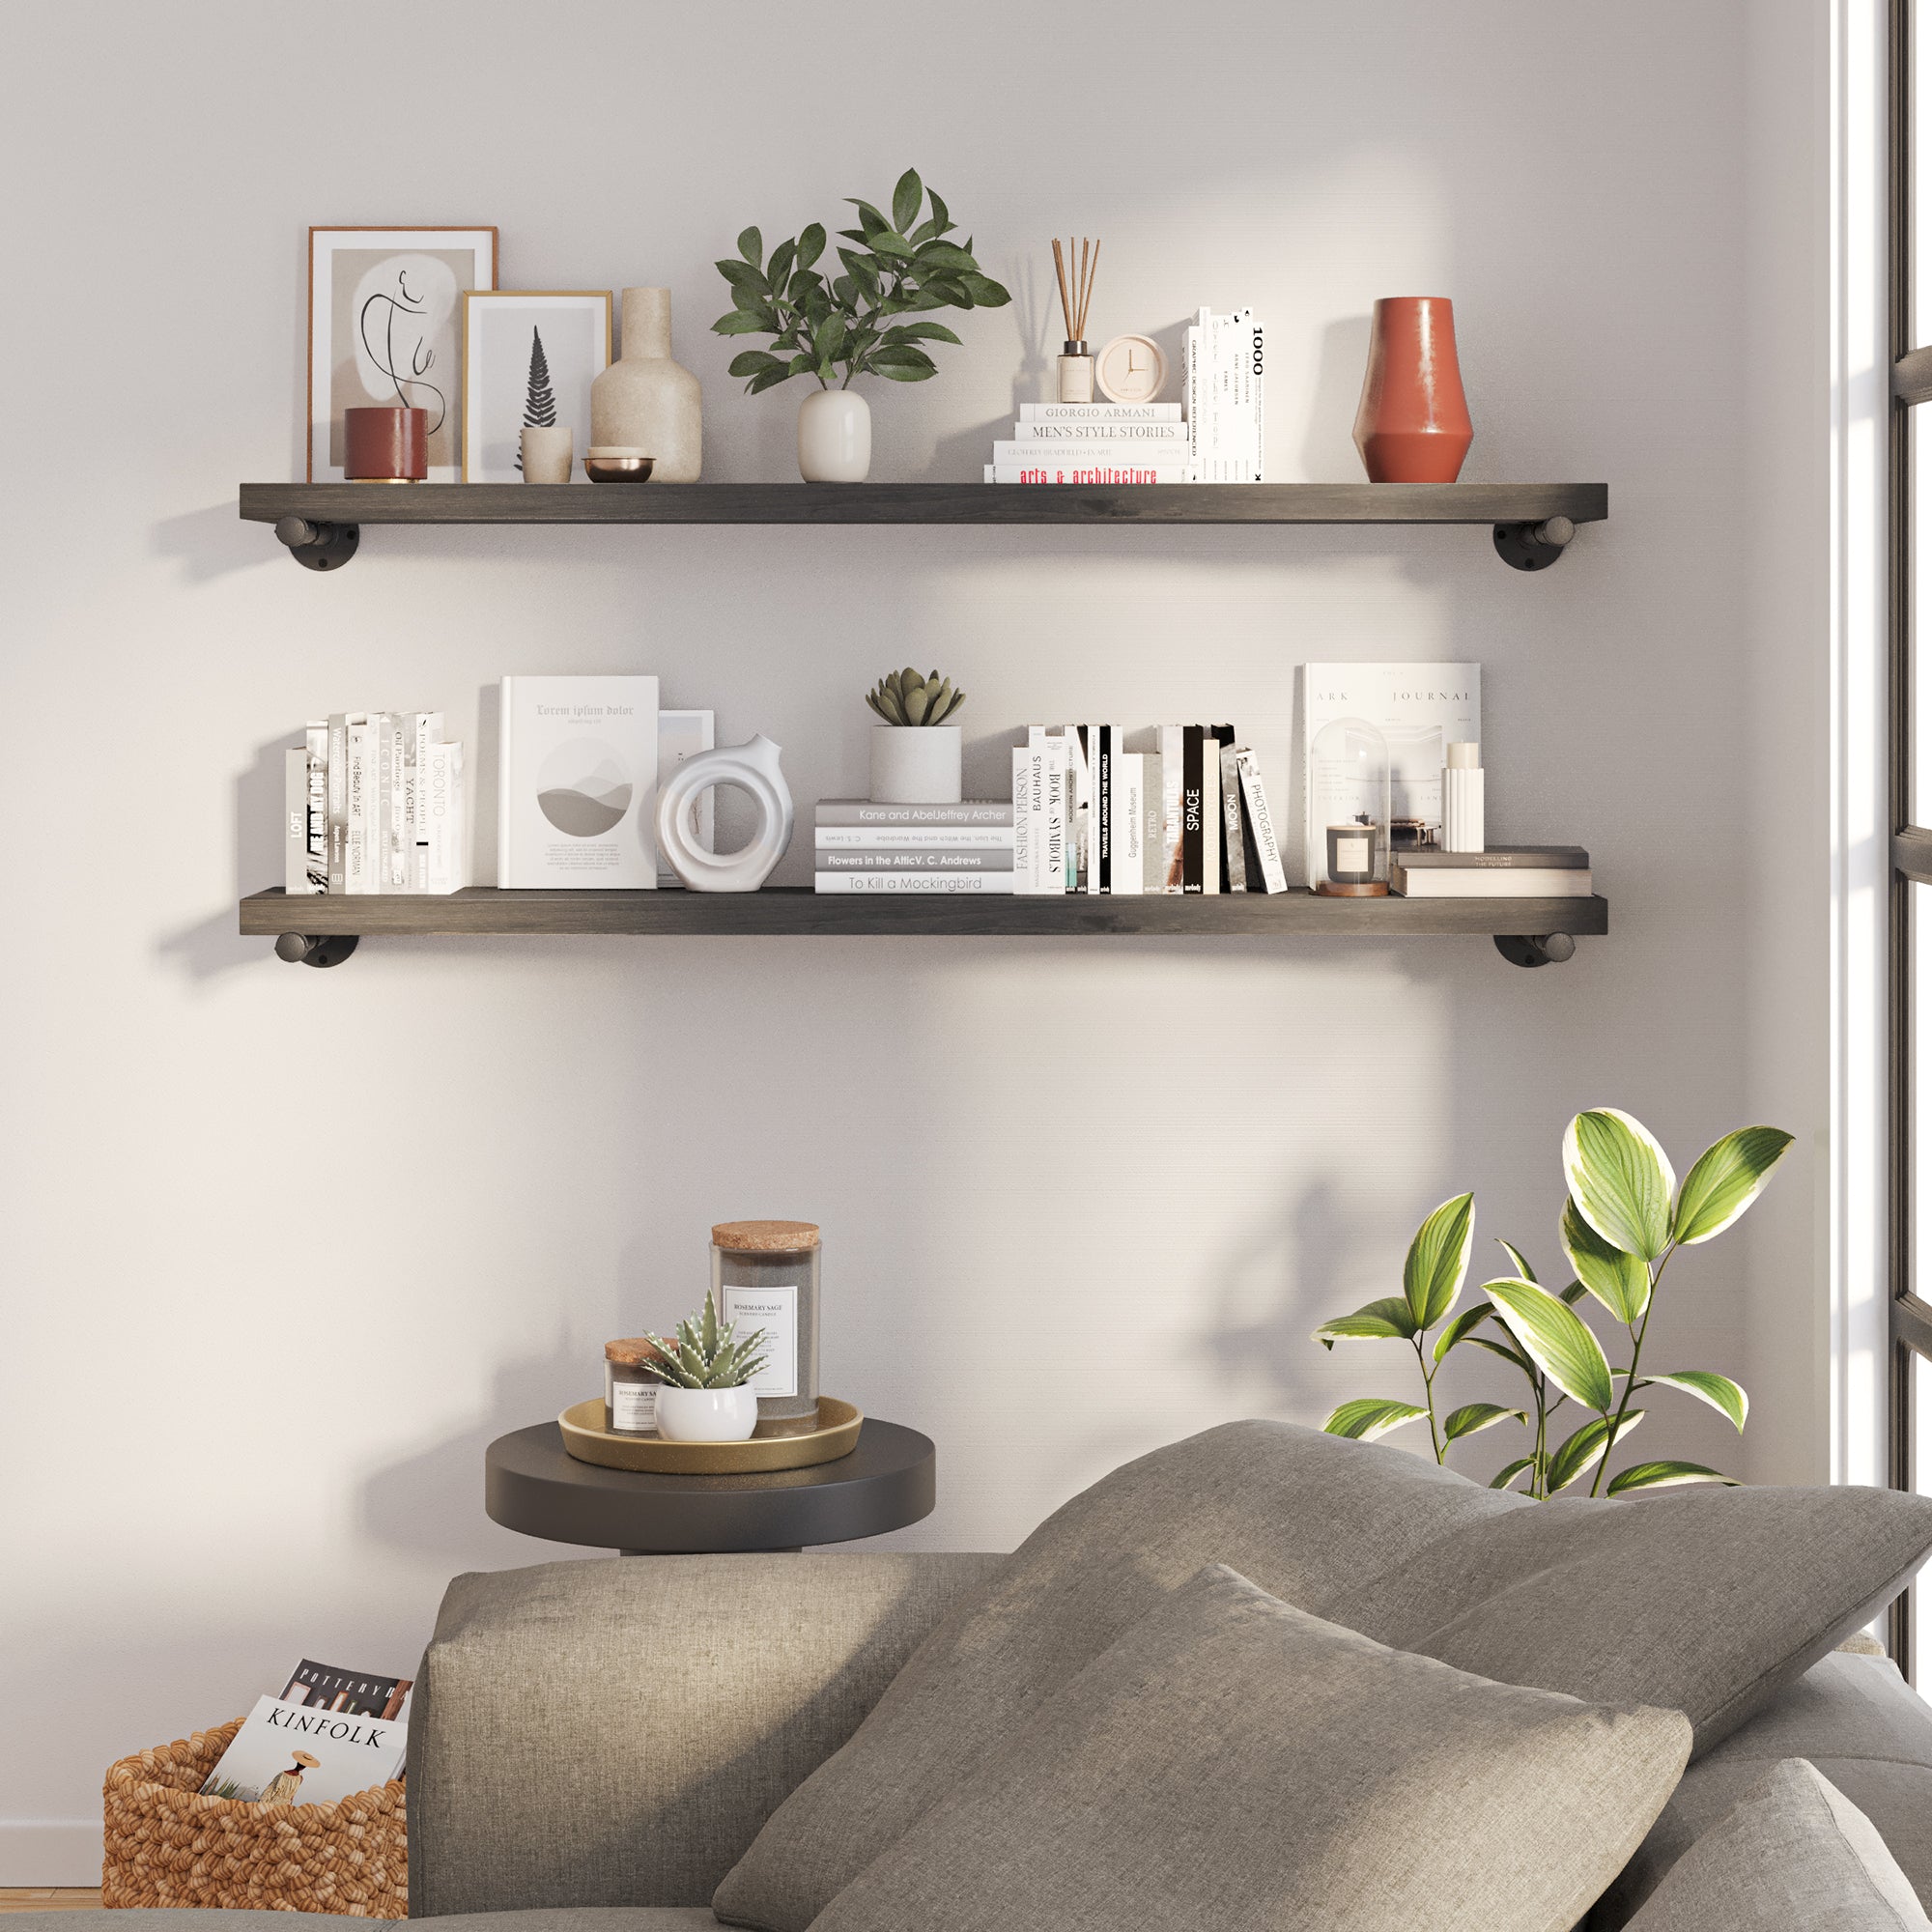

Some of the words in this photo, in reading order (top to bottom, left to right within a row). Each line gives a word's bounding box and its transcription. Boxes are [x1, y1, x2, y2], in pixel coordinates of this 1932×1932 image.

[1252, 326, 1264, 376] 1000
[1045, 408, 1099, 417] GIORGIO
[1103, 408, 1155, 417] ARMANI
[1033, 426, 1072, 439] MEN'S
[1075, 426, 1117, 439] STYLE
[1120, 426, 1175, 439] STORIES
[1020, 467, 1047, 484] arts
[1056, 469, 1065, 484] &
[1072, 467, 1157, 484] architecture
[536, 703, 570, 716] Lorem
[606, 704, 635, 716] dolor
[1316, 691, 1349, 701] ARK
[1392, 691, 1470, 702] JOURNAL
[331, 726, 343, 775] Watercolor
[393, 731, 403, 745] Oil
[352, 756, 362, 770] Find
[381, 739, 390, 806] ICONIC
[310, 772, 325, 794] DOG
[331, 777, 343, 813] Portraits
[351, 771, 362, 794] Beauty
[432, 753, 446, 817] TORONTO
[1016, 767, 1028, 813] PERSON
[1032, 755, 1041, 811] BAUHAUS
[1048, 773, 1061, 806] BOOK
[310, 796, 325, 811] MY
[351, 804, 361, 817] ART
[406, 778, 415, 824] YACHT
[859, 810, 886, 820] Kane
[888, 810, 910, 820] and
[972, 810, 1006, 820] Archer
[1128, 786, 1137, 815] Museum
[1166, 781, 1179, 843] TARANTULAS
[1186, 788, 1200, 832] SPACE
[1226, 793, 1238, 831] MOON
[290, 810, 302, 838] LOFT
[310, 813, 325, 835] AND
[1148, 810, 1157, 838] RETRO
[1207, 772, 1217, 861] MOTORCYCLES
[1250, 783, 1278, 863] PHOTOGRAPHY
[310, 837, 325, 851] ME
[351, 830, 361, 845] ELLE
[1016, 817, 1028, 870] FASHION
[1048, 816, 1061, 873] SYMBOLS
[1128, 815, 1140, 859] Guggenheim
[351, 847, 361, 876] NORMAN
[828, 855, 864, 866] Flowers
[865, 855, 874, 866] in
[875, 855, 892, 866] the
[926, 855, 938, 866] C.
[940, 855, 982, 866] Andrews
[849, 877, 865, 889] To
[867, 876, 884, 889] Kill
[887, 880, 896, 889] a
[900, 876, 982, 892] Mockingbird
[267, 1707, 387, 1748] KINFOLK
